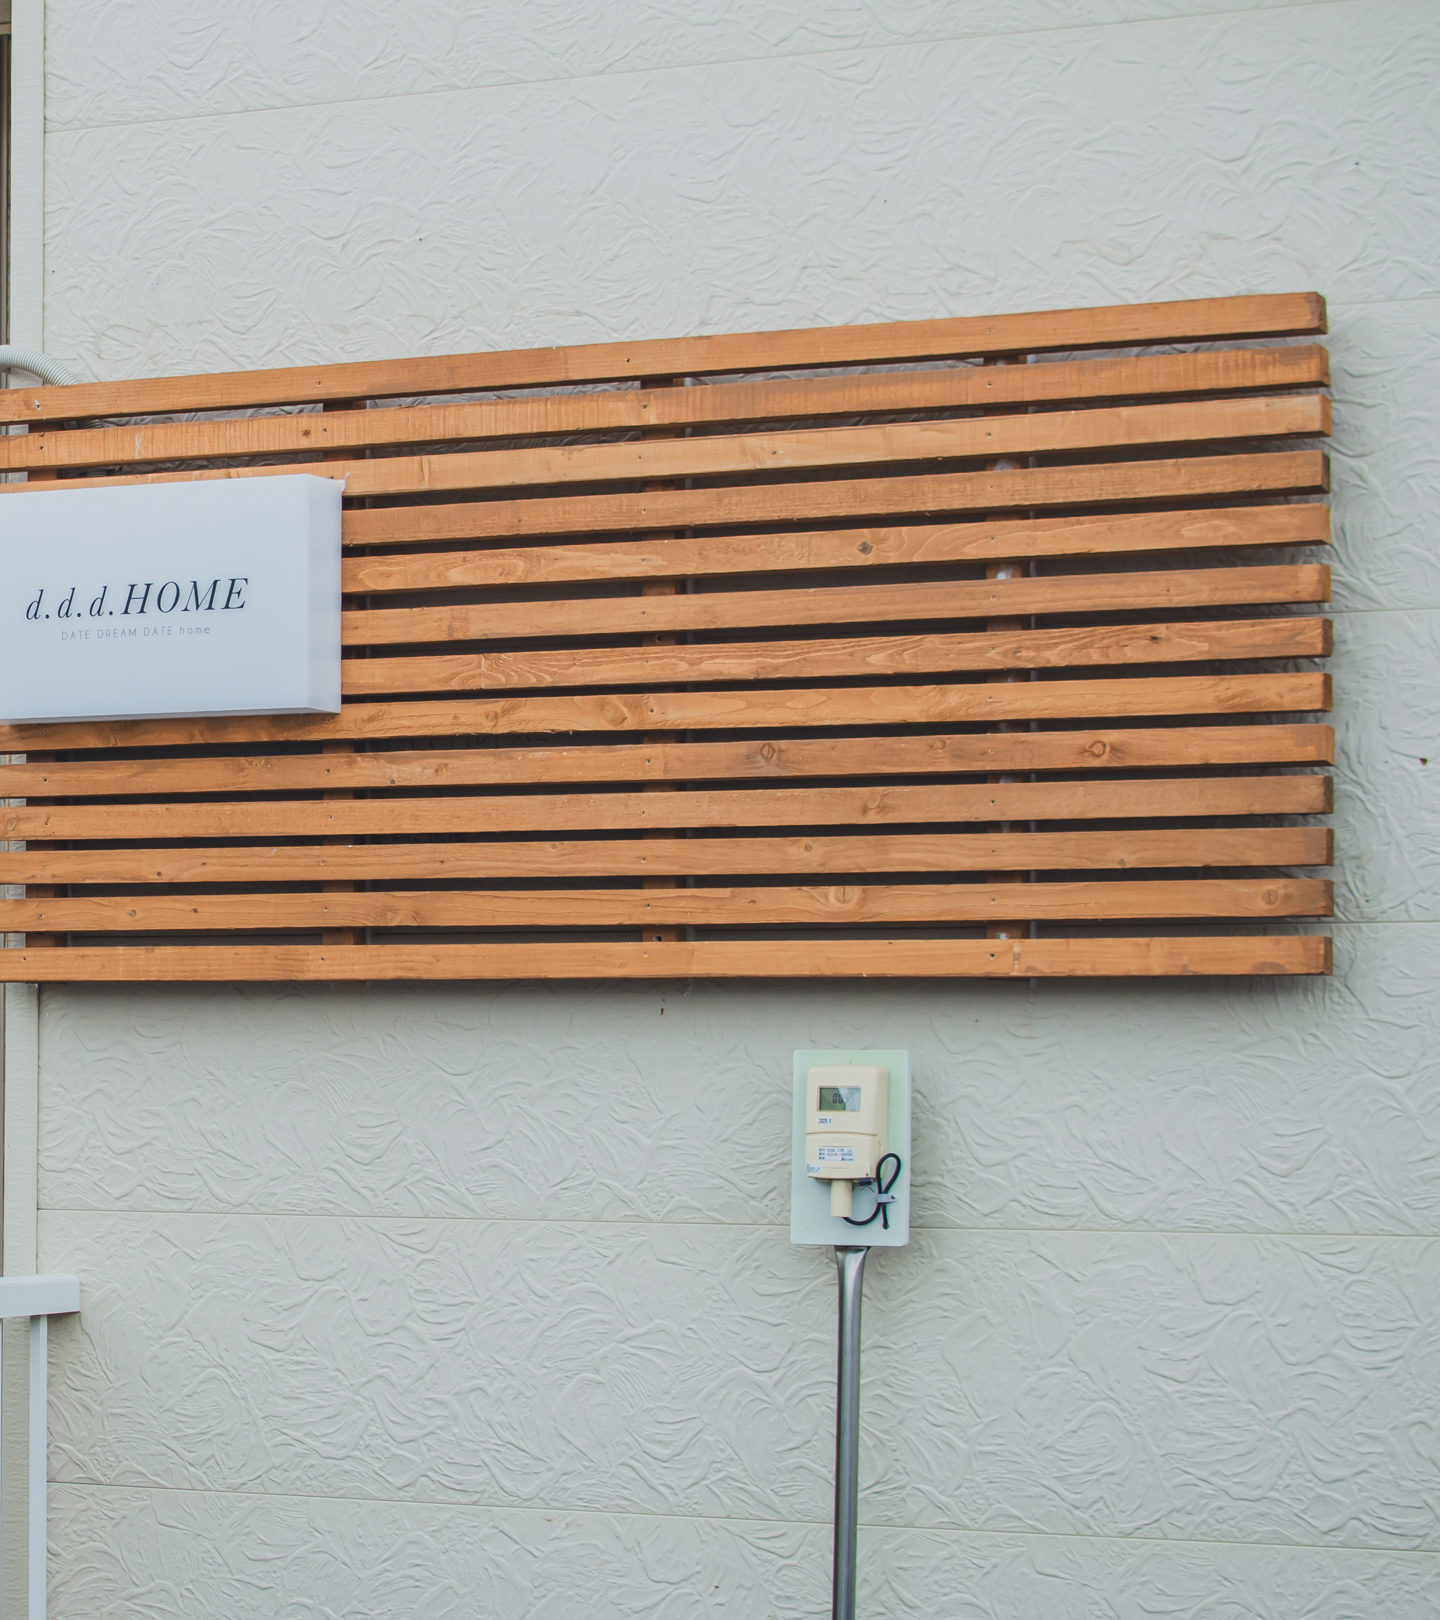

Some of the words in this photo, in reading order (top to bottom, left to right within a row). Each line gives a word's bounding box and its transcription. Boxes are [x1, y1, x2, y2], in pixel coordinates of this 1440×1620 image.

[25, 577, 249, 621] d.d.d.HOME
[61, 628, 91, 641] DATE
[97, 627, 138, 640] DREAM
[143, 625, 174, 638] DATE
[179, 624, 211, 636] home
